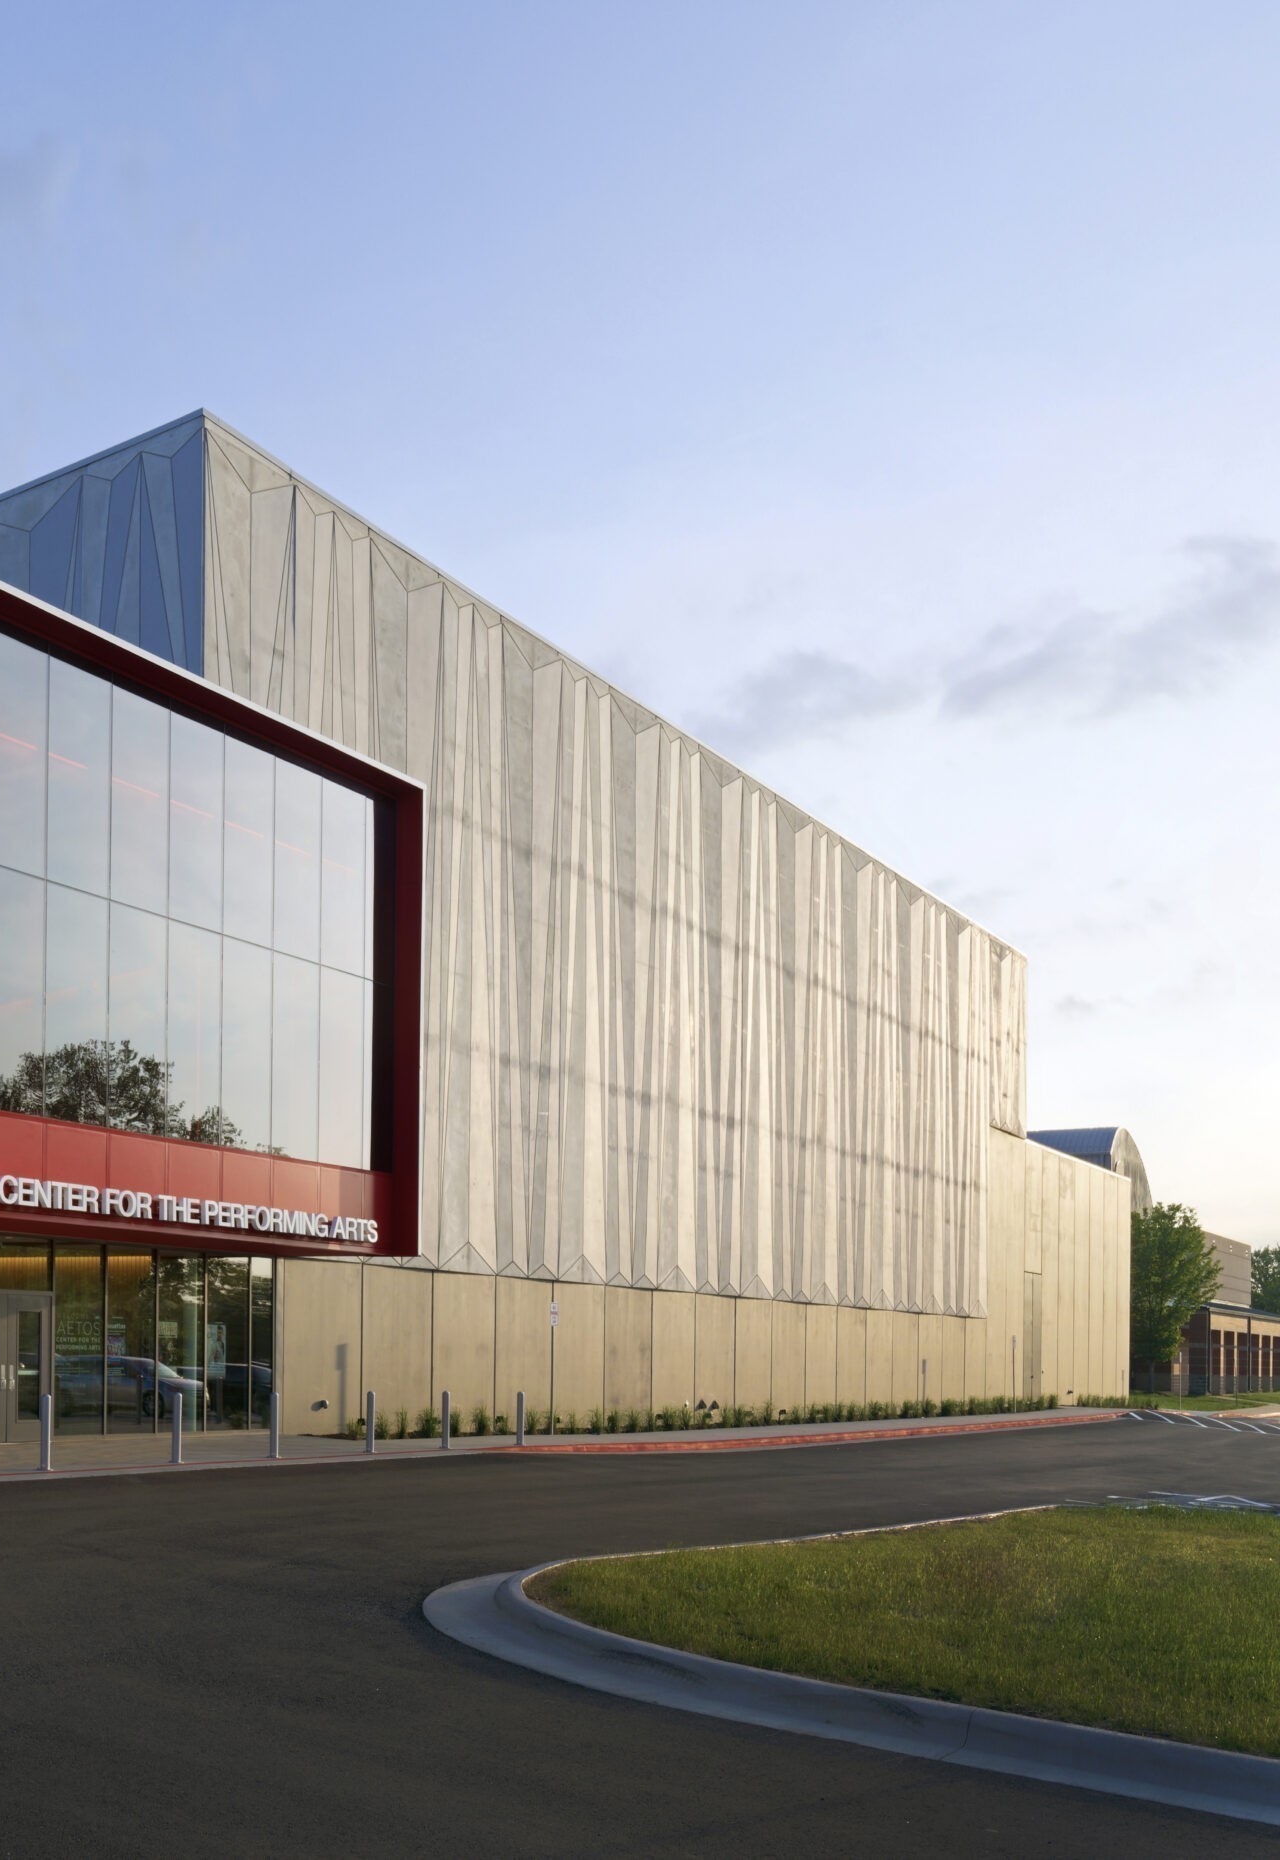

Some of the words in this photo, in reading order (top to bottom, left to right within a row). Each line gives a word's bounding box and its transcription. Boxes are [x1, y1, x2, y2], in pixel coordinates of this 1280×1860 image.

[101, 1188, 152, 1219] FOR
[154, 1194, 200, 1224] THE
[201, 1200, 329, 1237] PERFORMING
[329, 1216, 378, 1243] ARTS
[56, 1320, 101, 1336] AETOS
